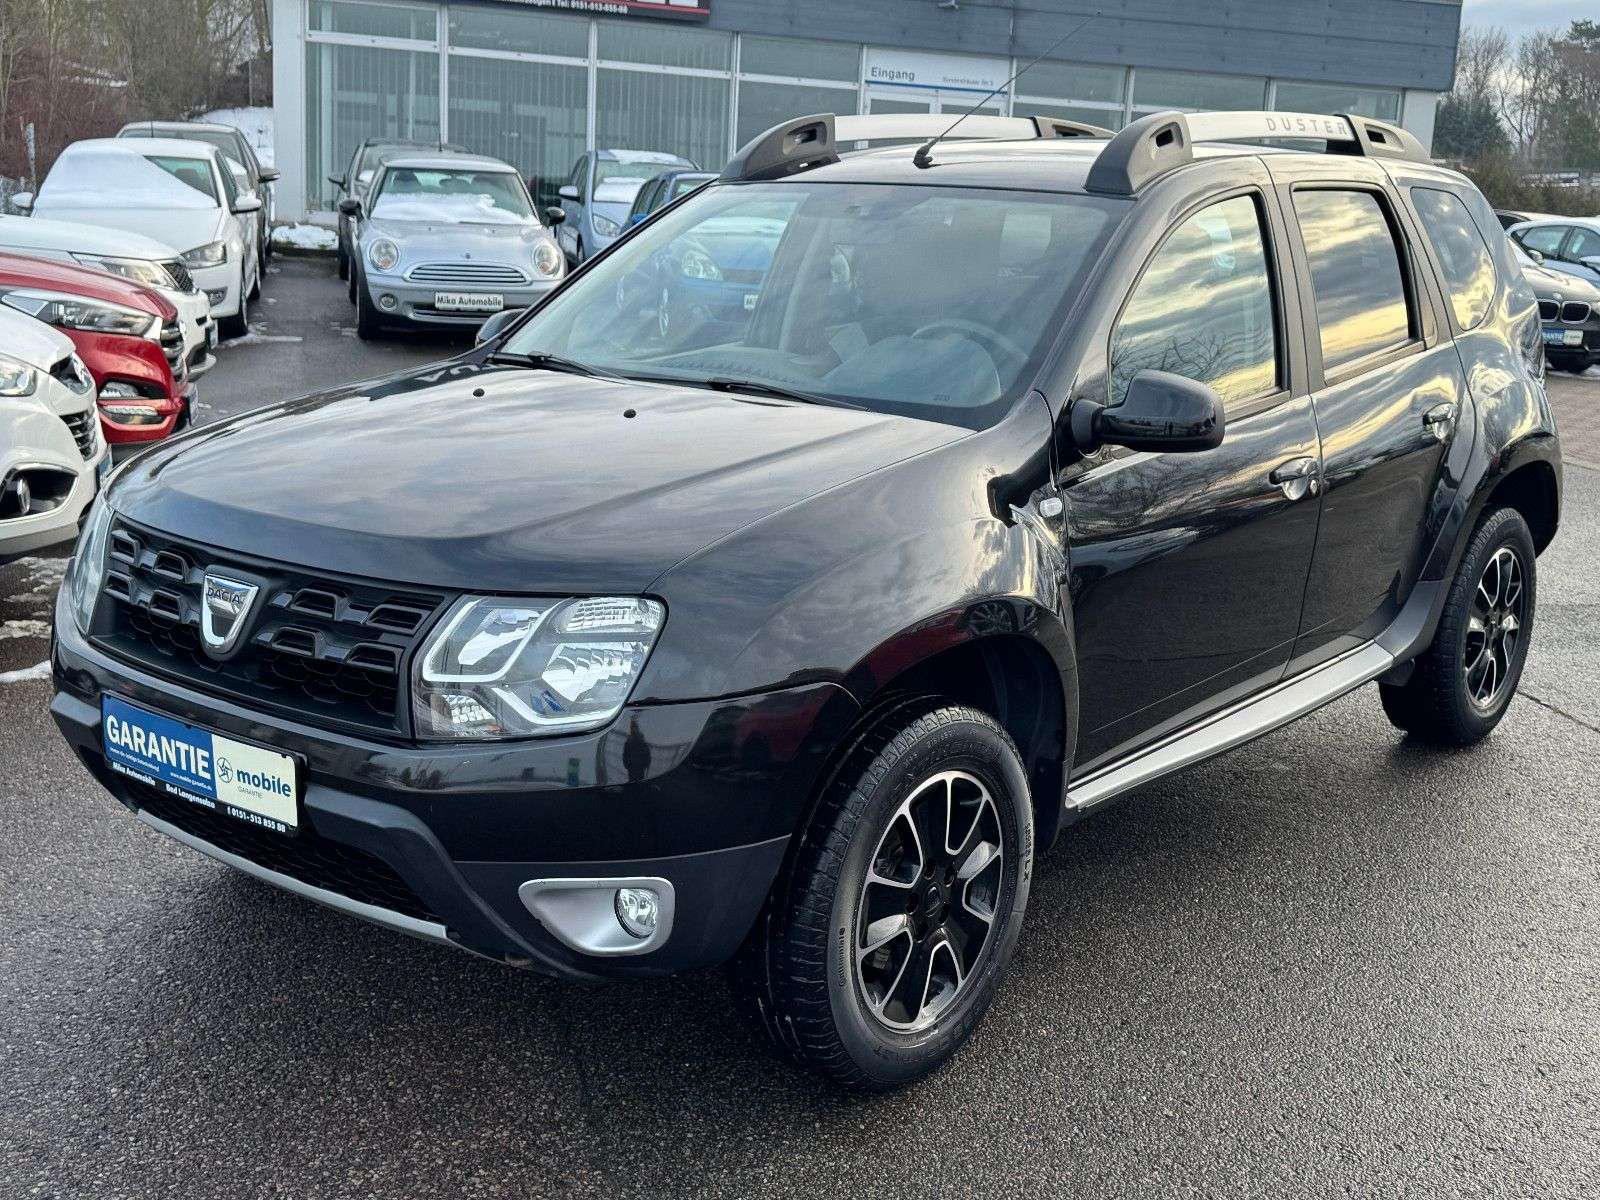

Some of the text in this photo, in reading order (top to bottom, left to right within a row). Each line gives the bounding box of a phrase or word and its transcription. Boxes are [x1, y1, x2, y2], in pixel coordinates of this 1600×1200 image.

[871, 66, 915, 81] Eingang
[1265, 117, 1348, 135] DUSTER
[437, 295, 502, 306] Mika Automobile
[207, 587, 240, 604] DACIA
[106, 714, 211, 780] GARANTIE
[236, 769, 292, 797] mobile
[113, 761, 126, 774] Mika
[126, 767, 156, 786] Automobile
[165, 783, 177, 795] Bad
[178, 787, 216, 808] Langensalza
[263, 818, 276, 830] 855
[276, 823, 286, 833] 88
[237, 785, 263, 799] GARANTIE
